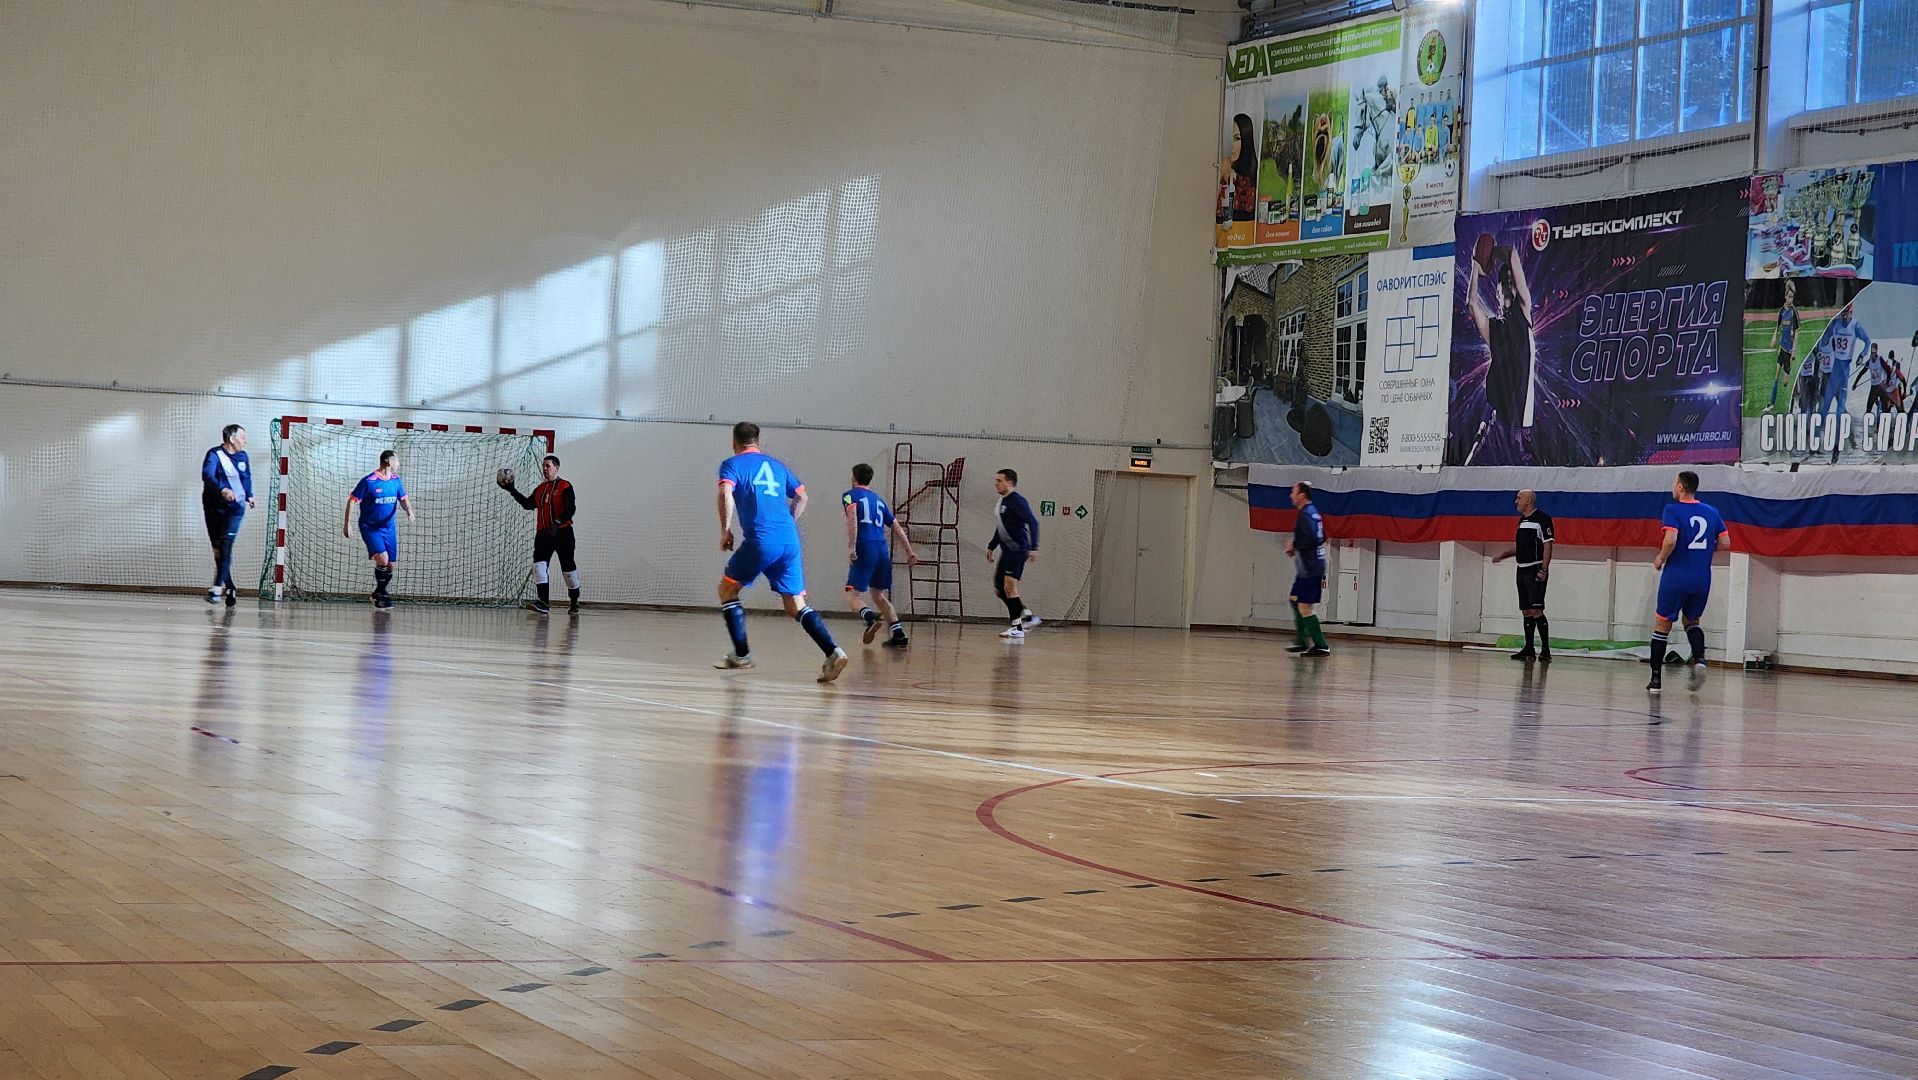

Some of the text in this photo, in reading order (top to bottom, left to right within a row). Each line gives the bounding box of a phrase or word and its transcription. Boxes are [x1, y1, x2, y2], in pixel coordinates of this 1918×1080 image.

[1226, 45, 1268, 82] VEDA
[1551, 208, 1684, 240] ТУРБОКОМПЛЕКТ
[1579, 280, 1728, 338] ЭНЕРГИЯ
[1570, 328, 1719, 383] СПОРТА
[1836, 337, 1849, 350] 83
[1656, 430, 1732, 444] WWW.KAMTURBO.RU
[752, 461, 781, 497] 4
[859, 496, 884, 528] 15
[1688, 515, 1707, 550] 2
